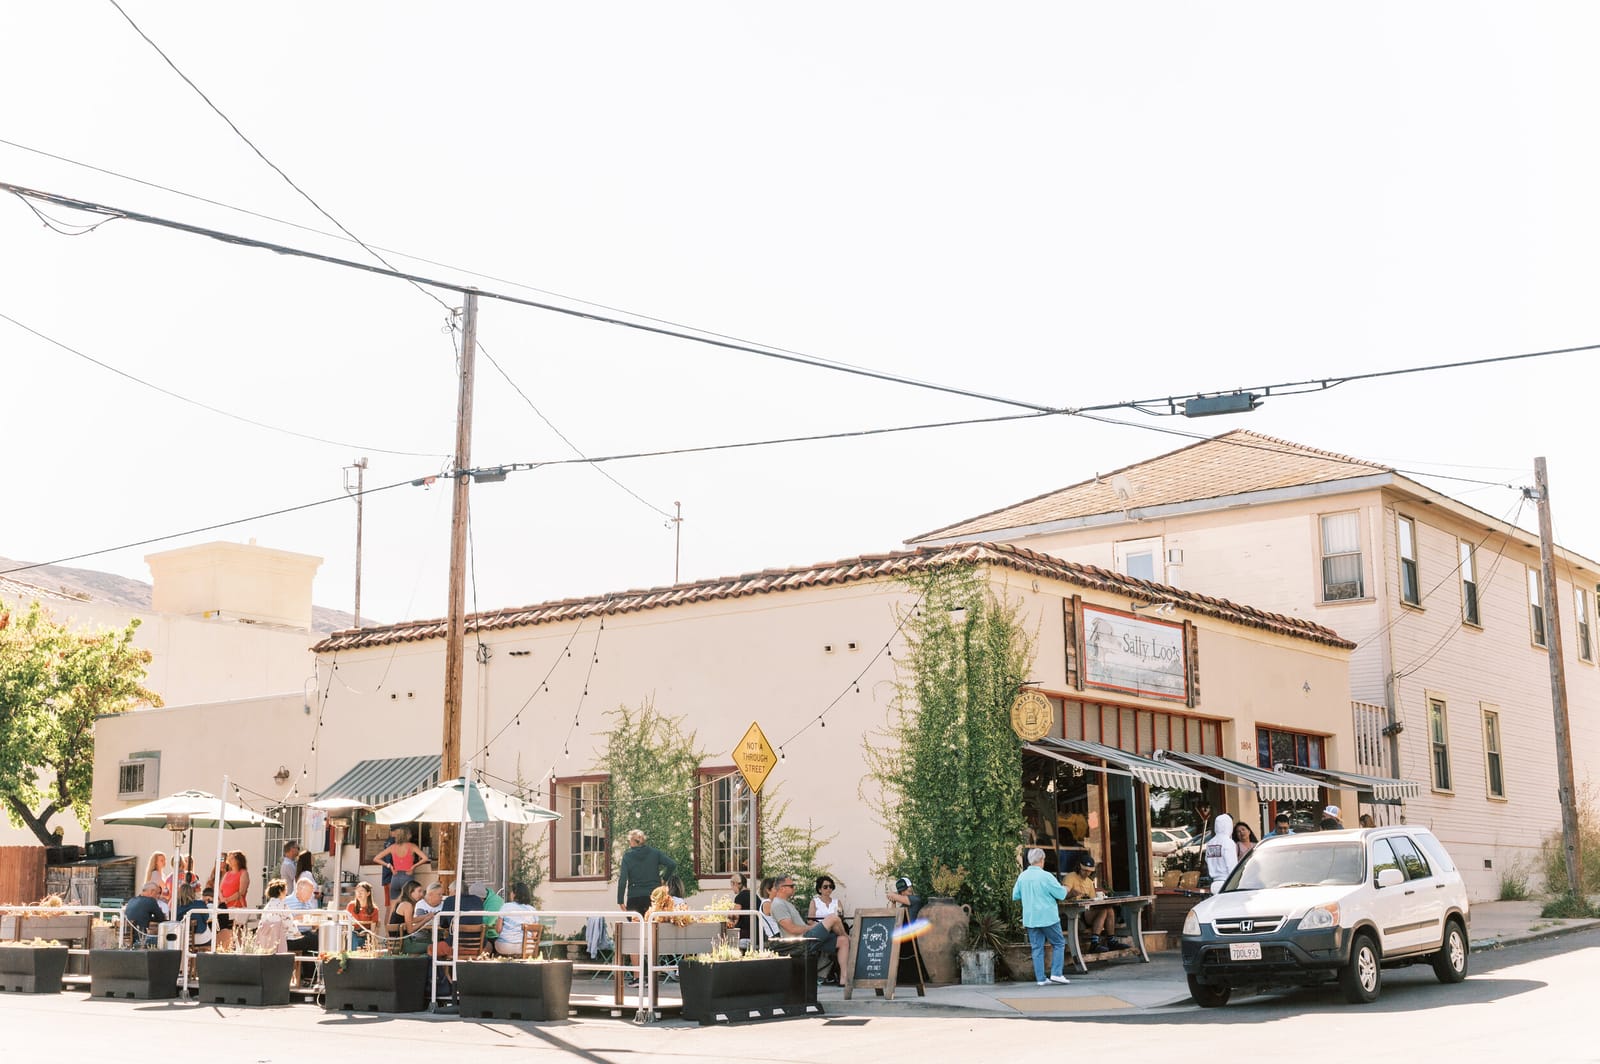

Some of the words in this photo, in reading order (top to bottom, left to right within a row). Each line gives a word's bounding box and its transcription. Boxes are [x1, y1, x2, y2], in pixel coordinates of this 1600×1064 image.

[1123, 633, 1149, 662] Sally
[1152, 638, 1181, 663] Loo's
[747, 741, 757, 750] NOT
[759, 743, 763, 751] A
[743, 753, 769, 763] THROUGH
[745, 765, 765, 773] STREET
